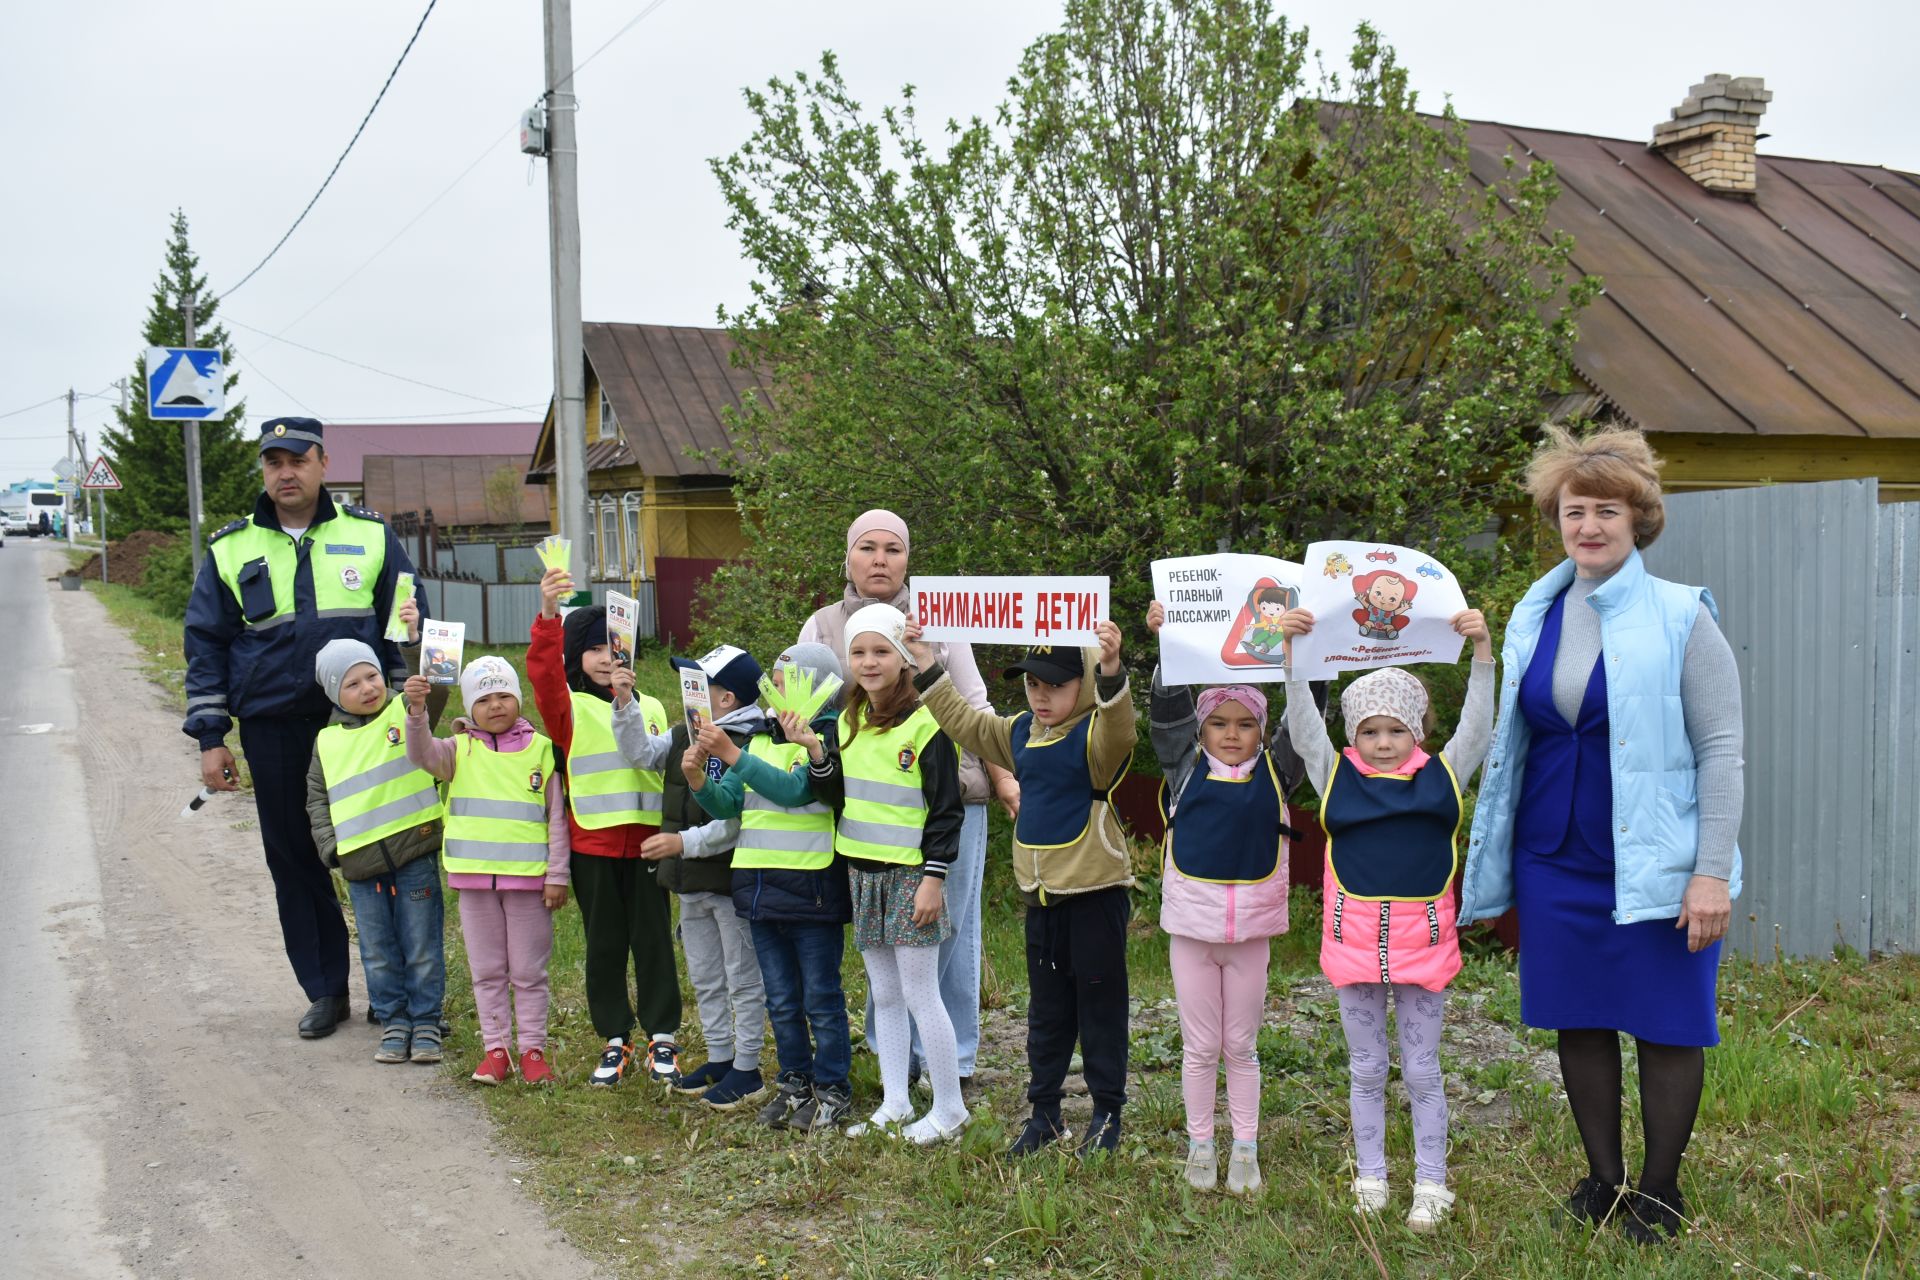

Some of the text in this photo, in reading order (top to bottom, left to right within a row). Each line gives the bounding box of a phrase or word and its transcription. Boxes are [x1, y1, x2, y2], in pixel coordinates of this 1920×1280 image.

[1168, 568, 1222, 583] РЕБЕНОК-
[1169, 586, 1223, 602] ГЛАВНЫЙ
[917, 591, 1099, 637] ВНИМАНИЕ ДЕТИ!
[1167, 609, 1231, 623] ПАССАЖИР!
[1323, 654, 1371, 663] главный
[705, 757, 722, 781] R
[1334, 893, 1344, 916] LOVE
[1381, 903, 1390, 926] LOVE
[1426, 903, 1438, 926] LOVE
[1333, 916, 1341, 938] LOVE
[1379, 926, 1389, 948] LOVE
[1379, 948, 1388, 970] LOVE
